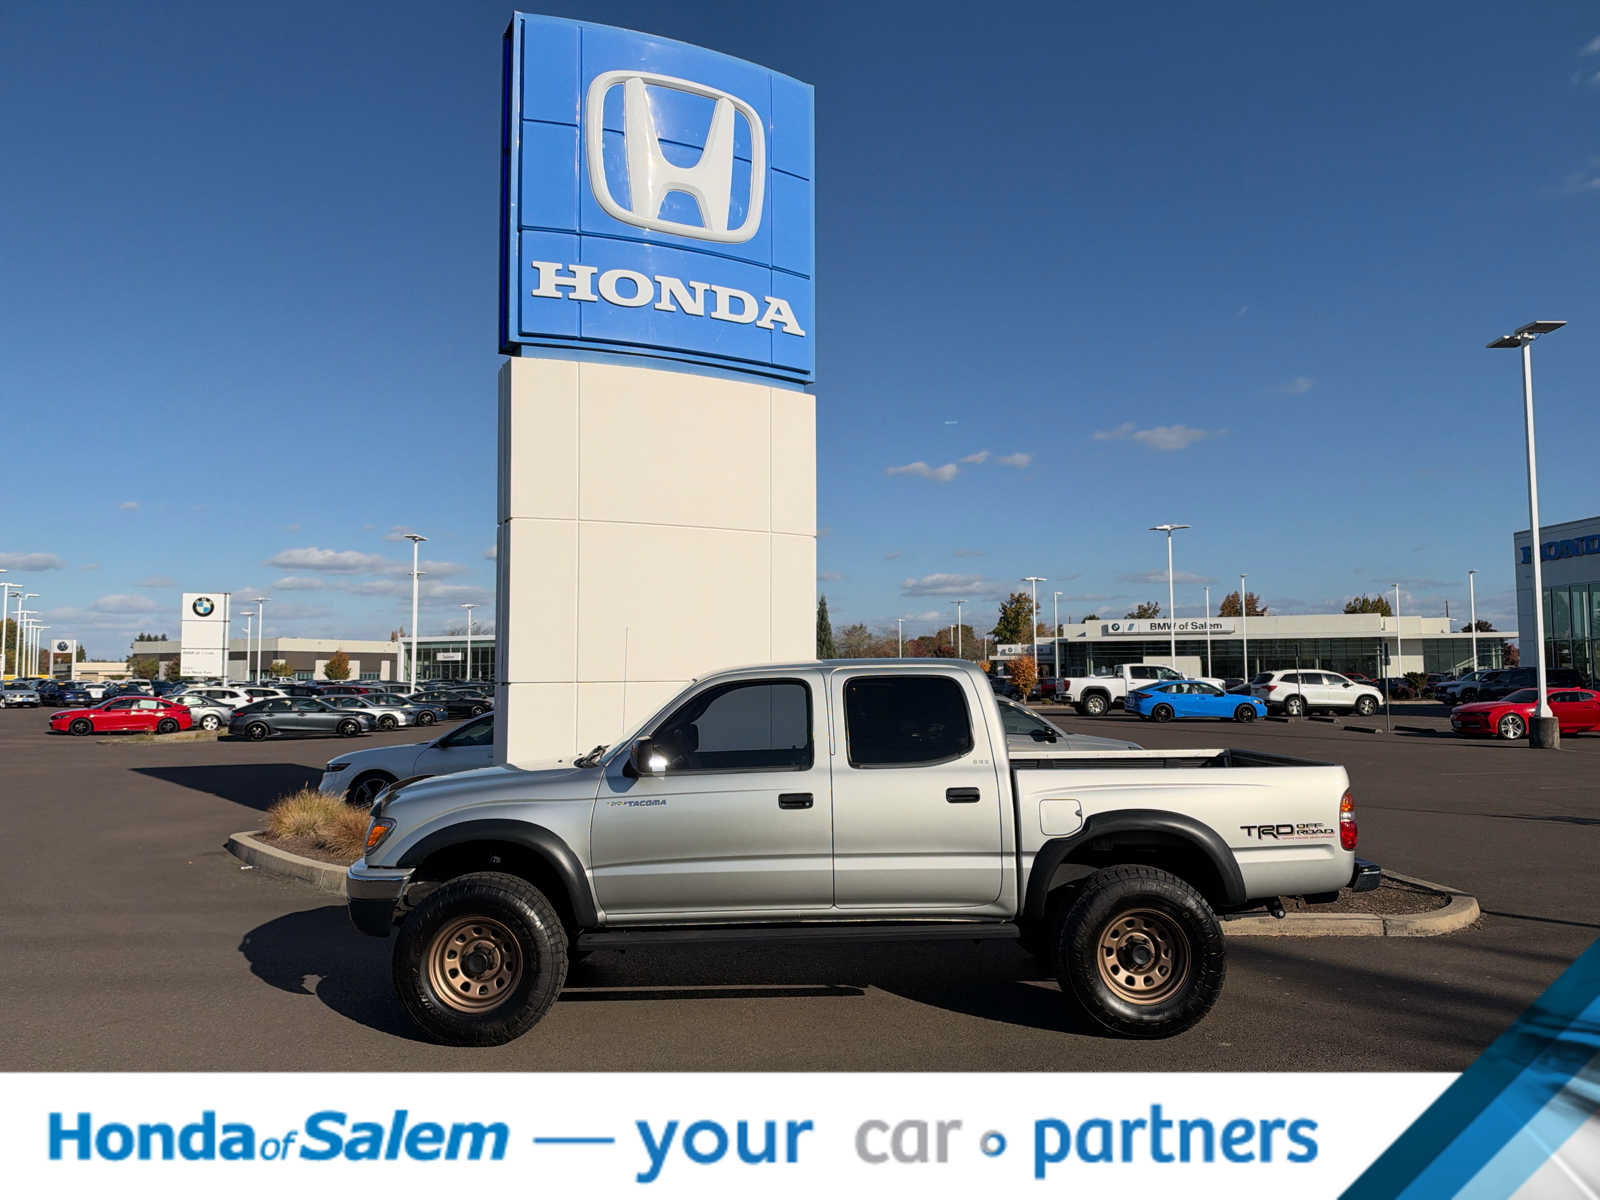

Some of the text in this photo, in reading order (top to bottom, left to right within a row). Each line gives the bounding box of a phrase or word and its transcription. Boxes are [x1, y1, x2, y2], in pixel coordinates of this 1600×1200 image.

[531, 260, 806, 337] HONDA
[1150, 621, 1223, 631] BMW of Salem
[628, 799, 667, 807] TACOMA
[1240, 823, 1294, 840] TRD
